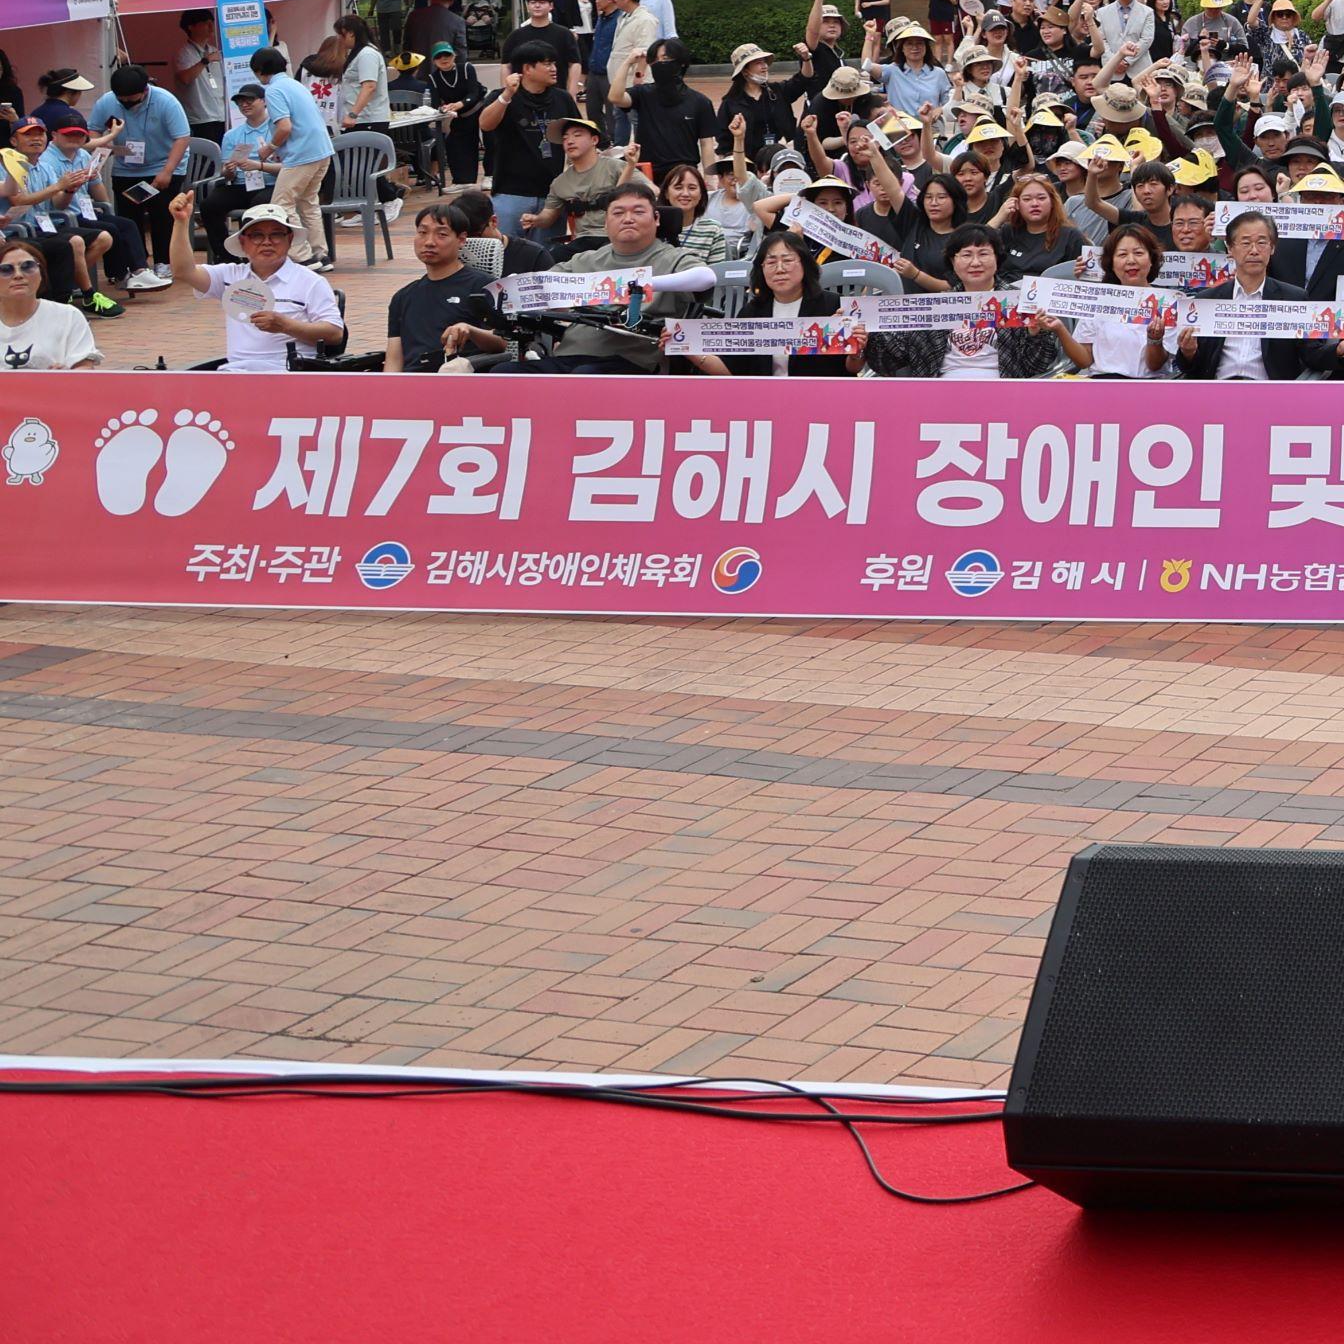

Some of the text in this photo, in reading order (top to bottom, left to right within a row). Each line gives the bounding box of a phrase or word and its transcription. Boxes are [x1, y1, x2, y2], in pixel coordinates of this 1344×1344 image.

[1264, 206, 1324, 216] 전국생활체육대축전
[1053, 282, 1135, 298] 2026 전국생활체육대축전
[878, 296, 972, 306] 2026 전국생활체육대축전
[1069, 302, 1152, 319] 전국어울림생활체육대축전
[1215, 304, 1307, 313] 2026 전국생활체육대축전
[902, 312, 996, 324] 전국어울림생활체육대축전
[724, 322, 794, 330] 전국생활체육대축전
[1237, 321, 1329, 331] 전국어울림생활체육대축전
[725, 338, 817, 347] 전국어울림생활체육대축전
[252, 416, 532, 520] 제7회
[568, 419, 876, 526] 김해시
[914, 421, 1225, 529] 장애인
[185, 543, 703, 589] 주최·주관 김해시장애인체육회
[860, 553, 934, 592] 후원
